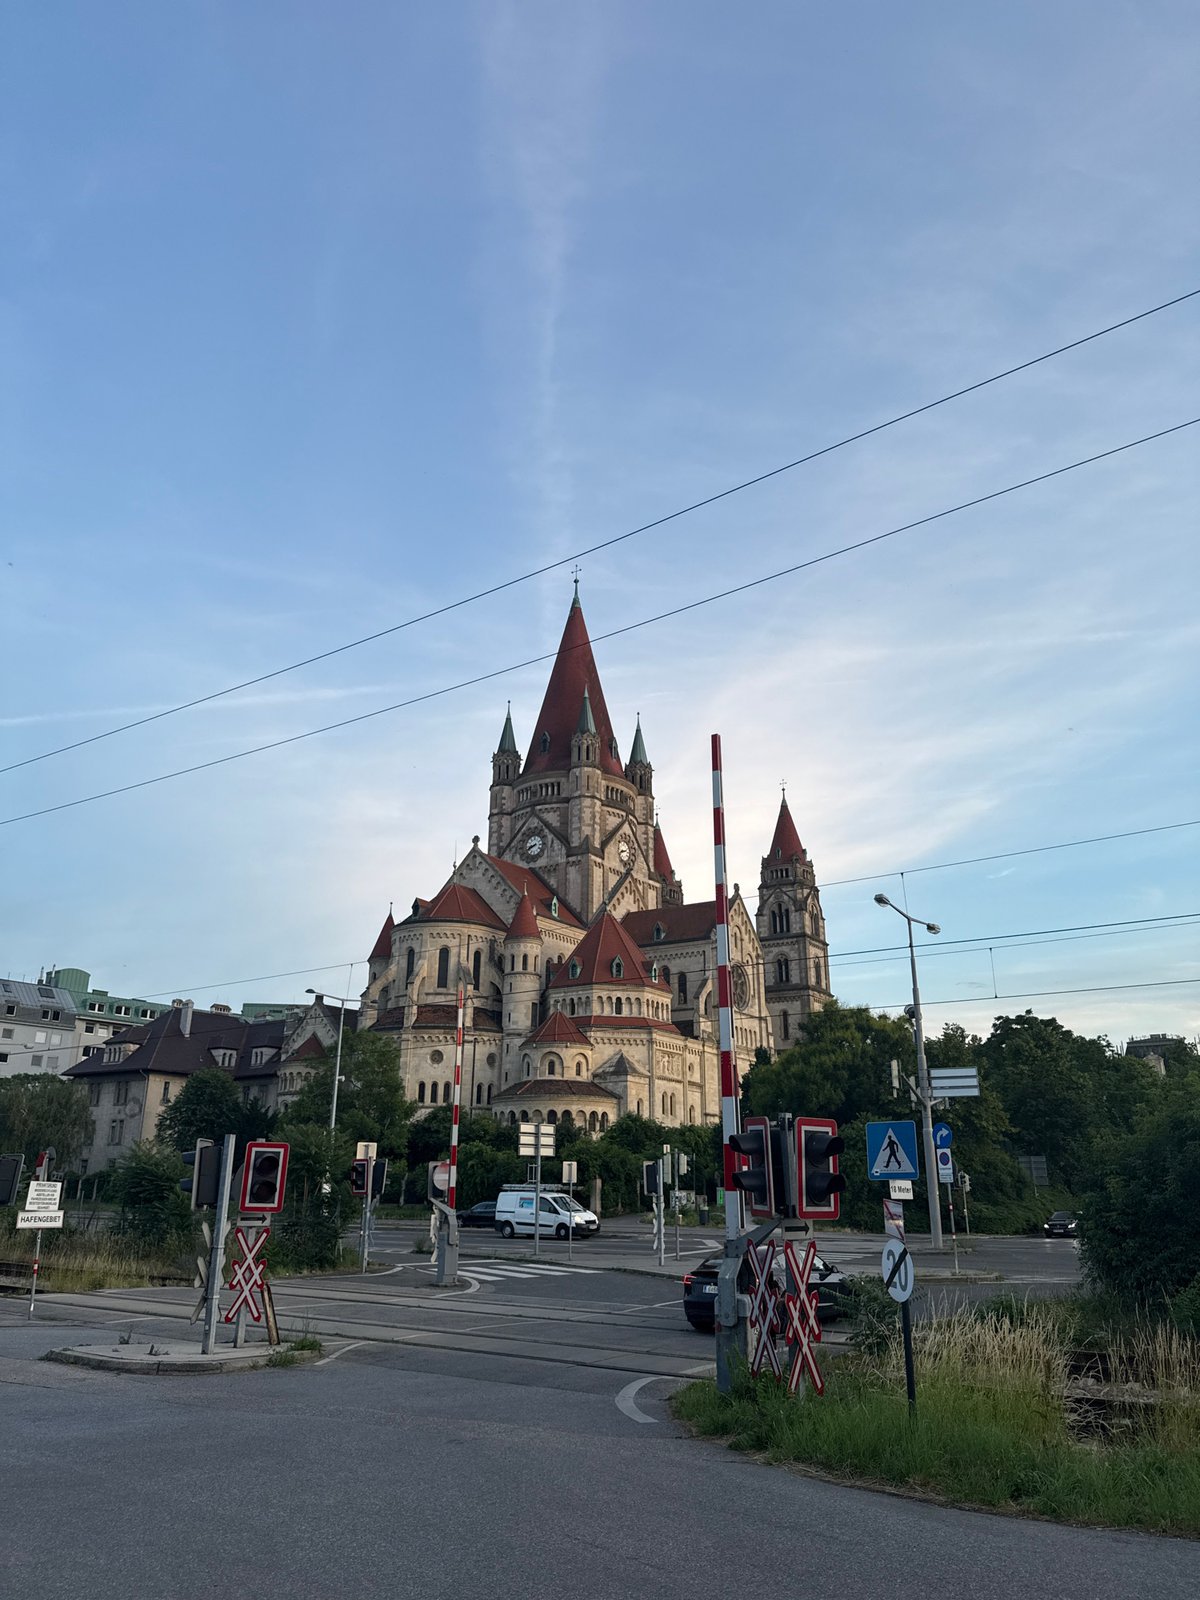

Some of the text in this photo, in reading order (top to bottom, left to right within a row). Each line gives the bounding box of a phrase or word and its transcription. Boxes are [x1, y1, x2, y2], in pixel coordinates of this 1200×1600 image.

[898, 1185, 912, 1194] Meter
[20, 1215, 61, 1223] HAFENGEBIET
[886, 1248, 909, 1292] 20
